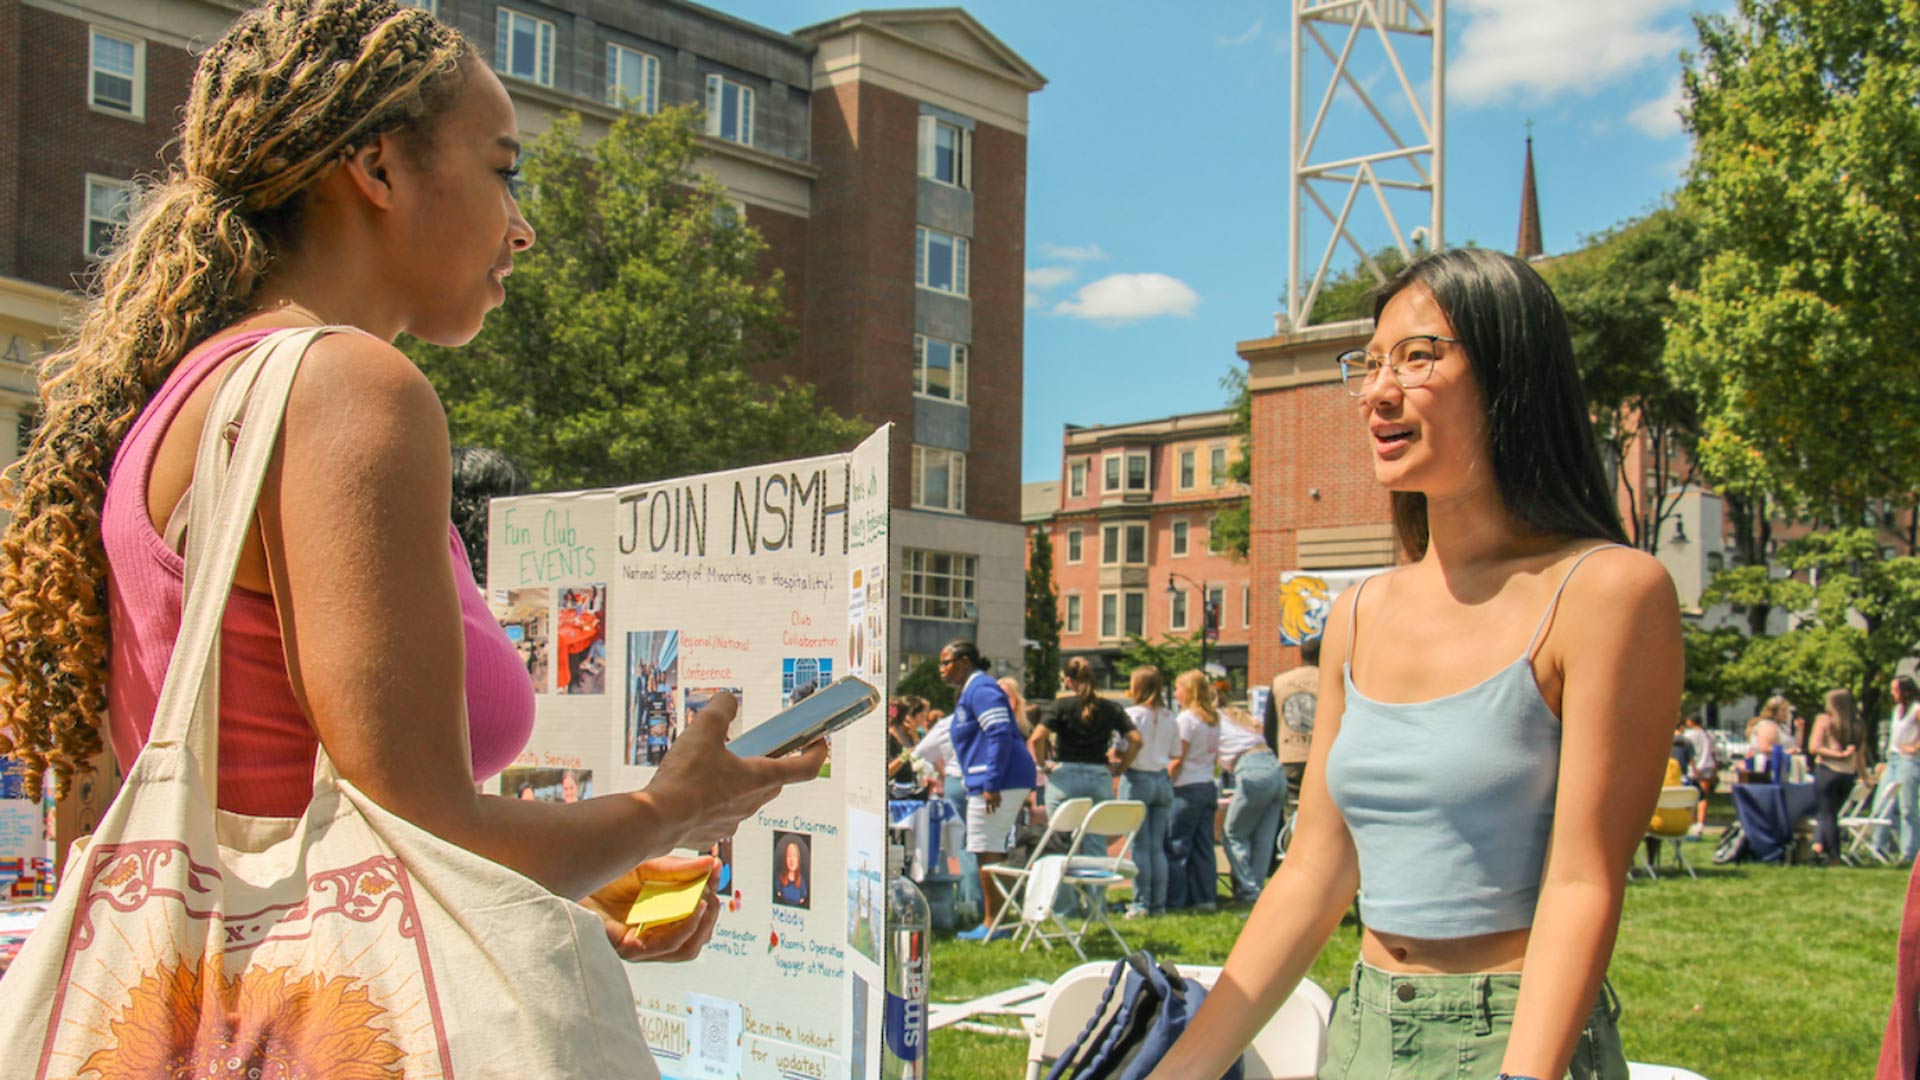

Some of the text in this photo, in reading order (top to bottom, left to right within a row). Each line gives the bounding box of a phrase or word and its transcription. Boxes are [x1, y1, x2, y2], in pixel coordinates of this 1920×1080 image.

[618, 483, 707, 557] JOIN
[731, 463, 852, 556] NSMH
[504, 507, 576, 547] Fun Club
[520, 546, 596, 585] EVENTS
[623, 564, 657, 580] National
[661, 565, 690, 587] Society
[707, 566, 752, 584] Minorities
[756, 572, 767, 583] in
[772, 571, 834, 604] Hospitality!
[791, 610, 811, 626] Club
[783, 629, 838, 648] Collaboration
[682, 655, 732, 680] Conference
[544, 751, 582, 768] Service
[757, 810, 838, 836] Former Chairman
[772, 907, 804, 931] Melody
[780, 933, 806, 952] Rooms
[775, 955, 805, 977] Voyager
[903, 955, 922, 1047] smart
[745, 1006, 835, 1049] Be on the lookout
[751, 1039, 827, 1079] for updates!
